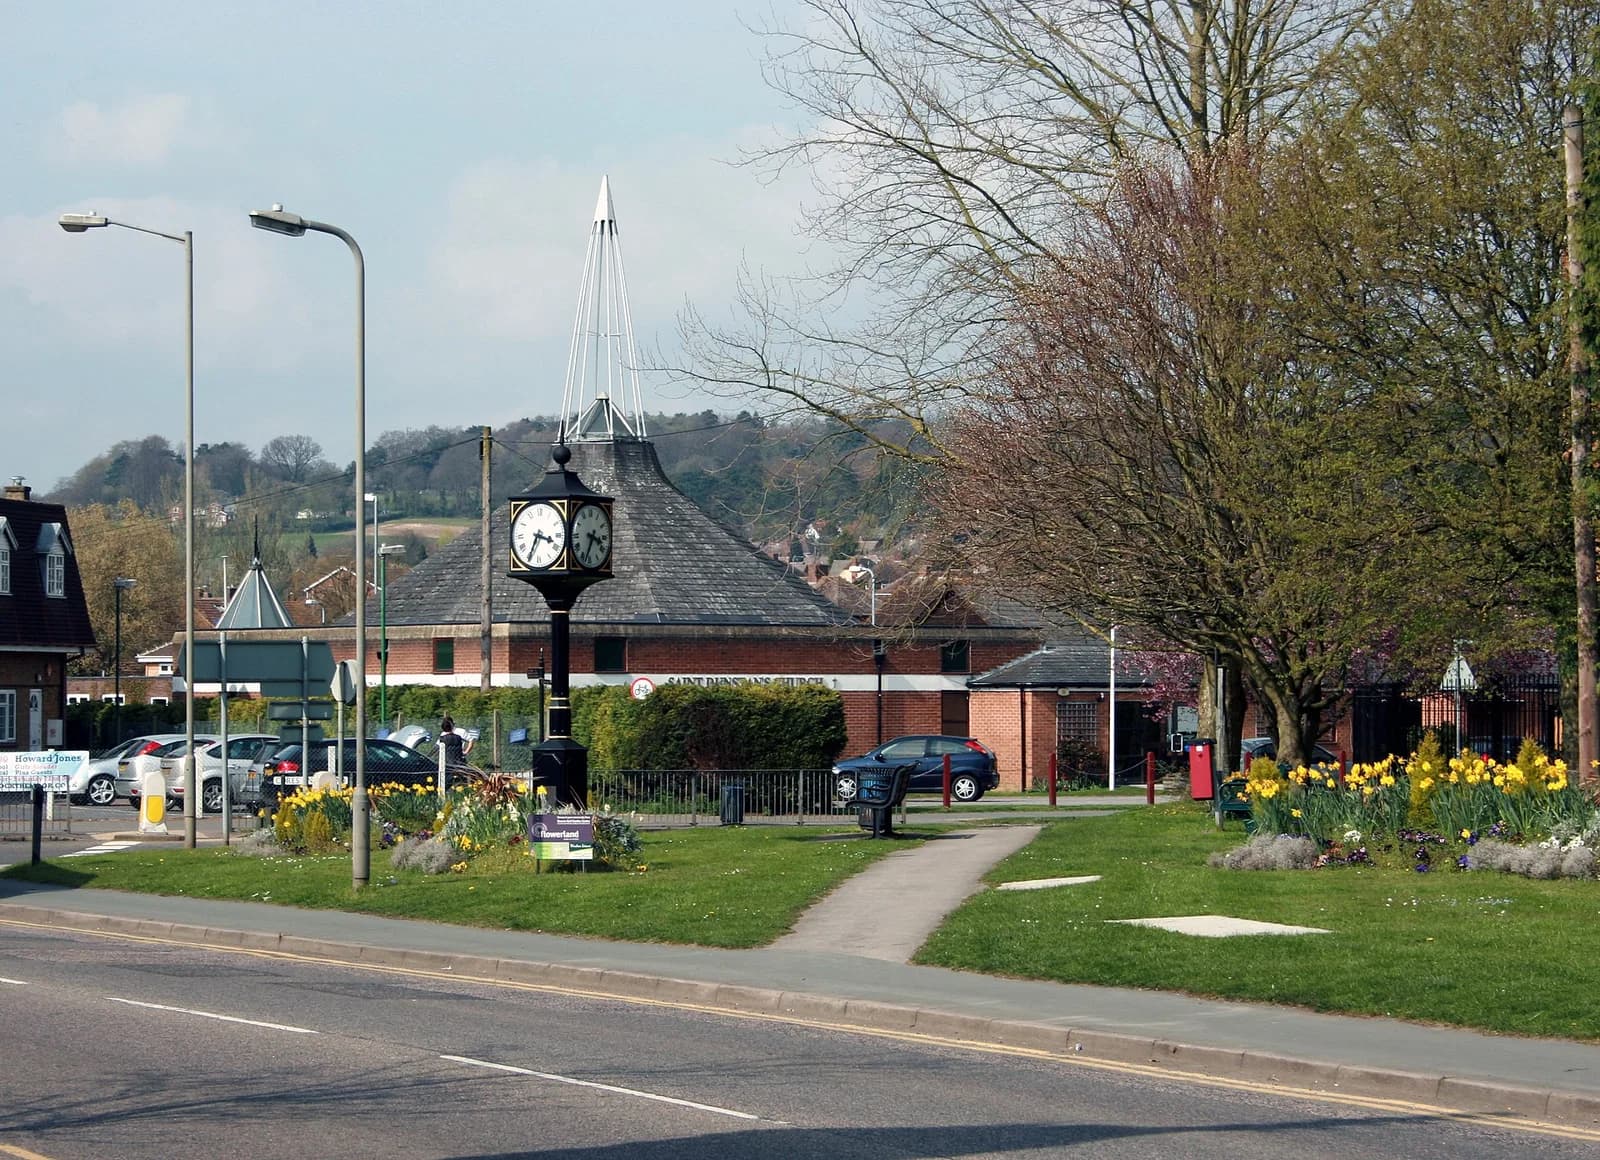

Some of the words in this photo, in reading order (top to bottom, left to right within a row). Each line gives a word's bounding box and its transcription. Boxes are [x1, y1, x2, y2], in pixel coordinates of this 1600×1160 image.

[667, 677, 703, 686] SAINT
[54, 753, 82, 764] Jones
[541, 830, 579, 838] flowerland
